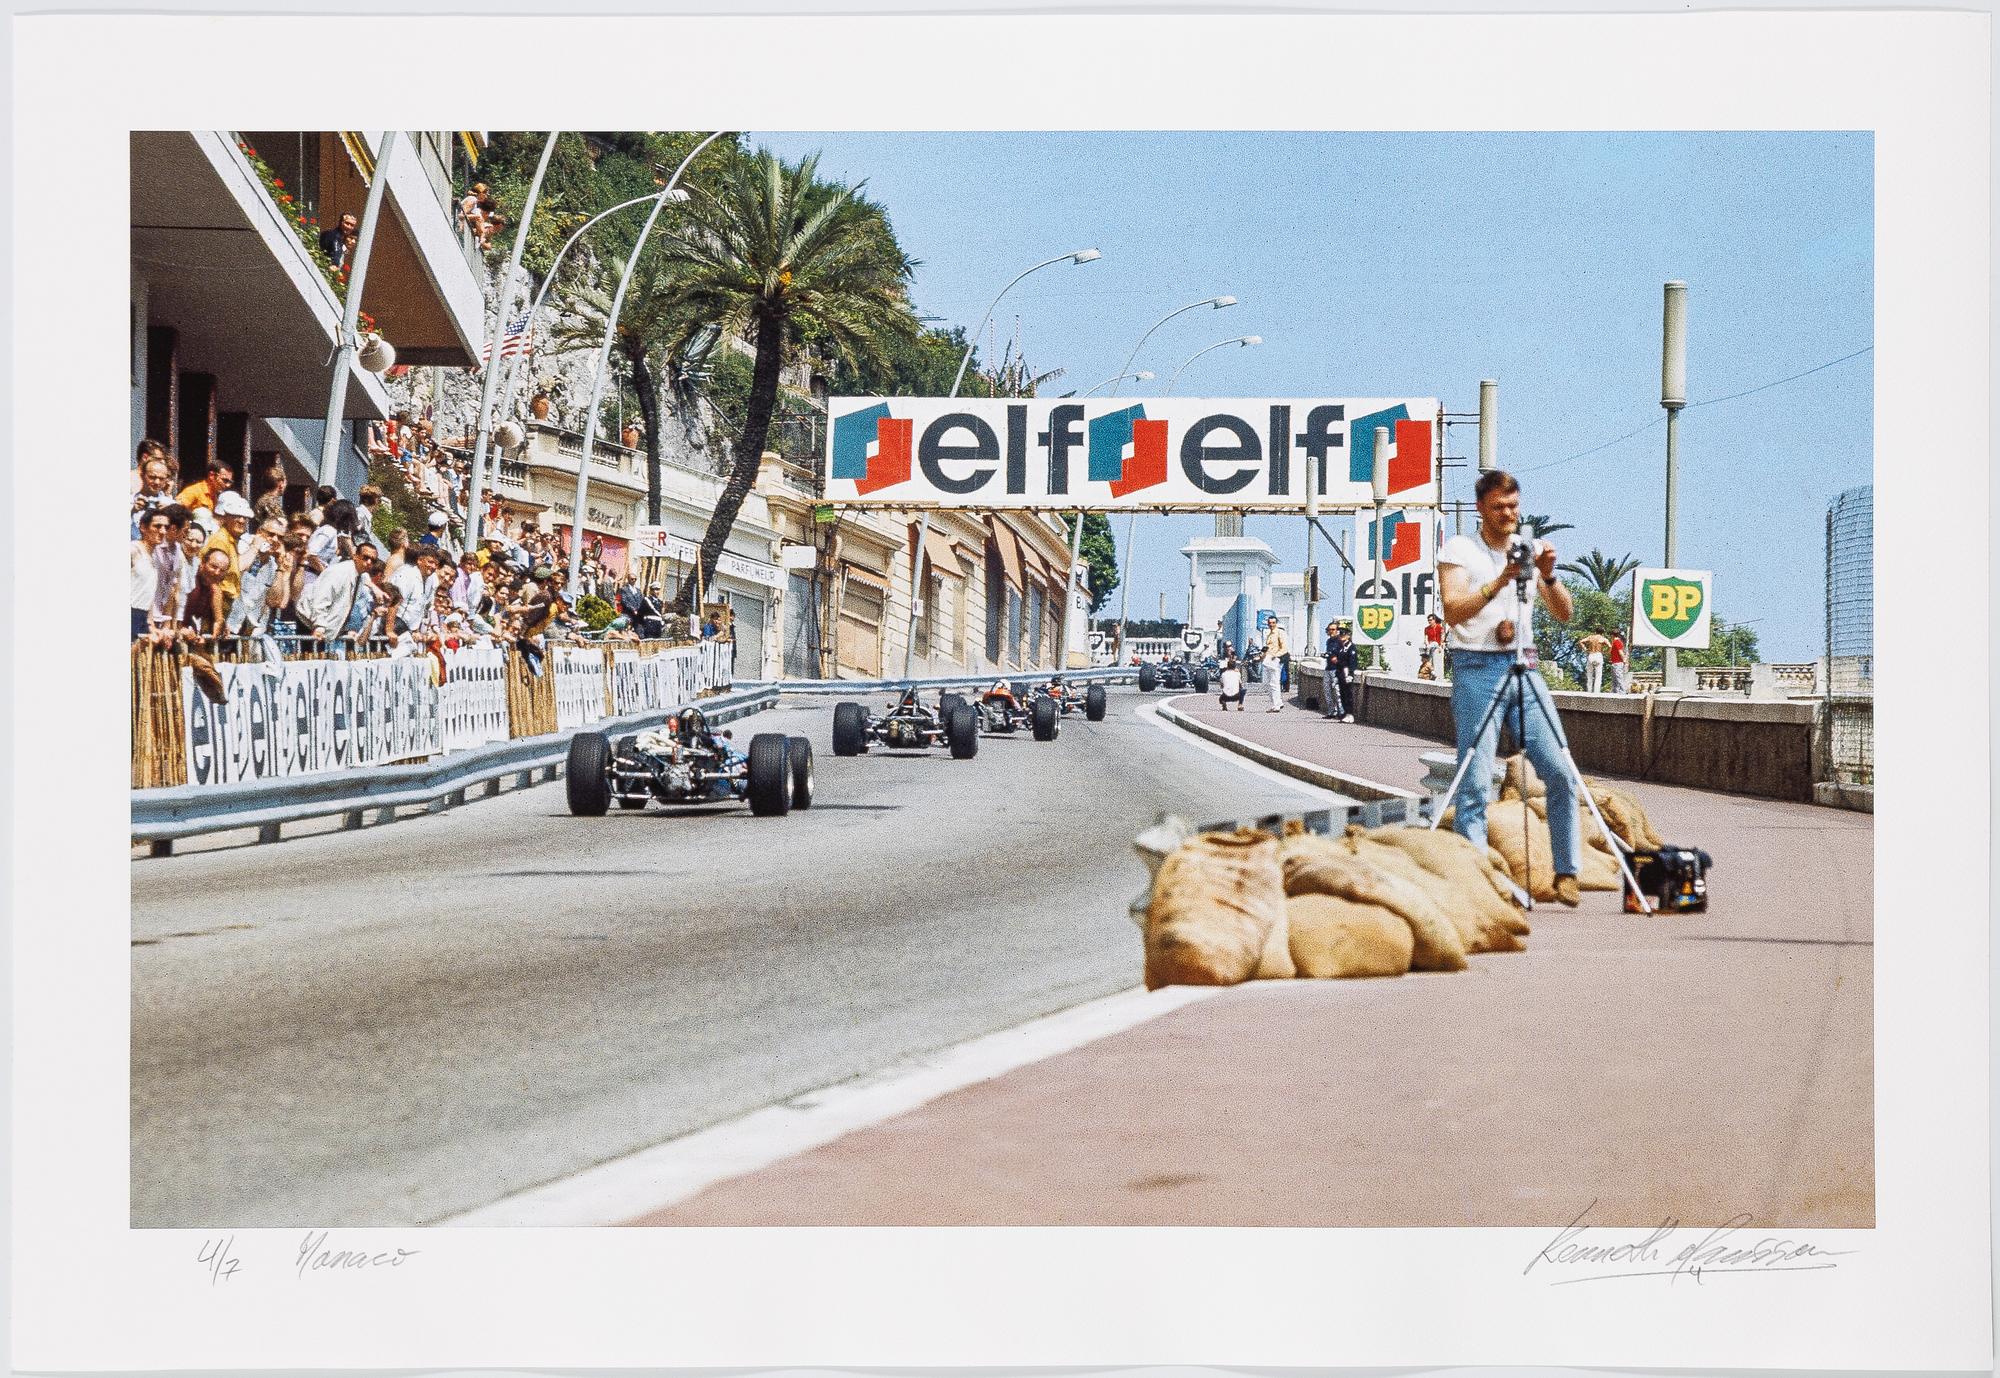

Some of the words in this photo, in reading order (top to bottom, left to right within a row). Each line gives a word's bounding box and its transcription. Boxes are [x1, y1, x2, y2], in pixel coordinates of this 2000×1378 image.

[918, 404, 1084, 495] elf
[1180, 404, 1344, 495] elf
[1362, 607, 1393, 630] BP
[1649, 584, 1701, 621] BP
[296, 1230, 421, 1280] Monaco
